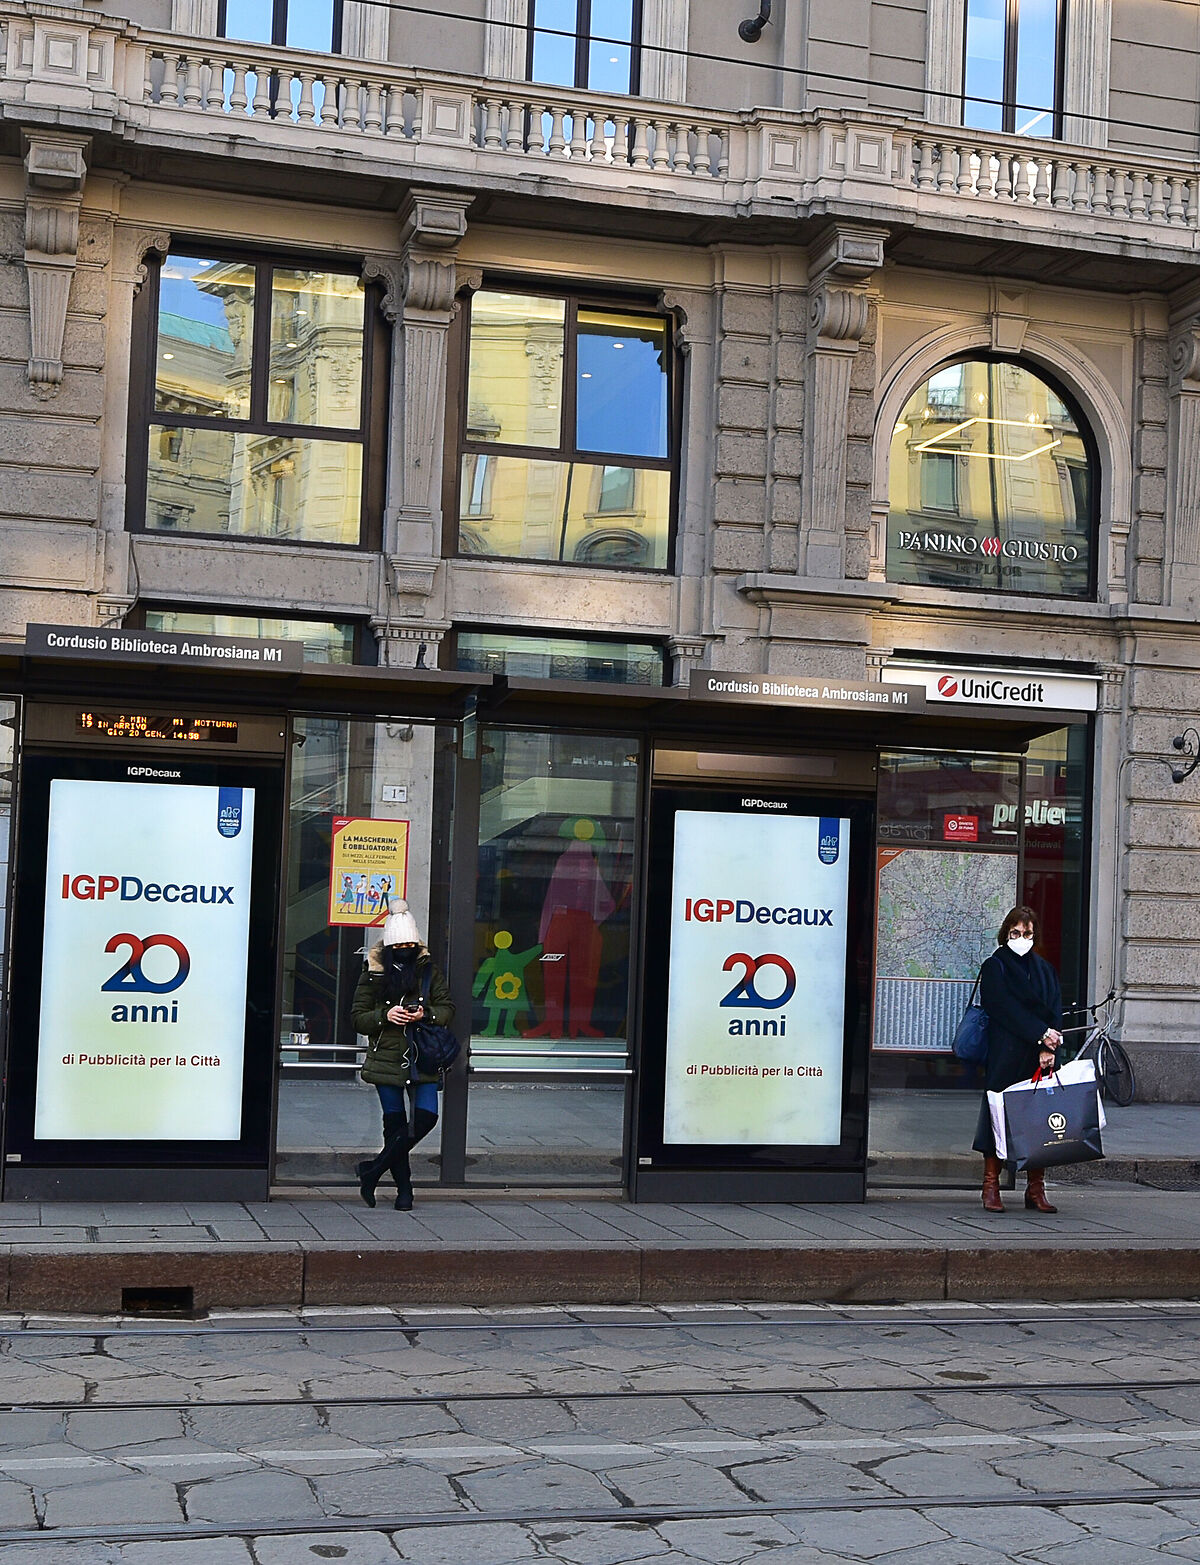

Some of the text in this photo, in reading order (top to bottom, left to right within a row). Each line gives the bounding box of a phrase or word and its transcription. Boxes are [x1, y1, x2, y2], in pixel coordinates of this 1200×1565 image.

[898, 531, 1078, 562] PANINO GIUSTO
[47, 632, 282, 661] Cordusio Biblioteca Ambrosiana M1
[708, 678, 908, 704] Cordusio Biblioteca Ambrosiana M1
[961, 679, 1044, 702] UniCredit
[81, 713, 147, 724] 16 2 MIN
[114, 722, 147, 730] ARRIVO
[195, 719, 238, 728] NOTTURNA
[129, 729, 140, 737] 20
[145, 730, 166, 738] GEN.
[127, 766, 181, 778] IGPDecaux
[741, 798, 788, 809] IGPDecaux
[349, 844, 397, 852] OBBLIGATORIA
[353, 836, 398, 844] MASCHERINA
[61, 874, 235, 904] IGPDecaux
[684, 898, 834, 926] IGPDecaux
[101, 932, 191, 994] 20
[719, 952, 797, 1010] 20
[111, 1000, 179, 1023] anni
[728, 1015, 787, 1036] anni
[62, 1054, 221, 1069] di Pubblicità per la Città
[686, 1064, 823, 1079] di Pubblicità per la Città
